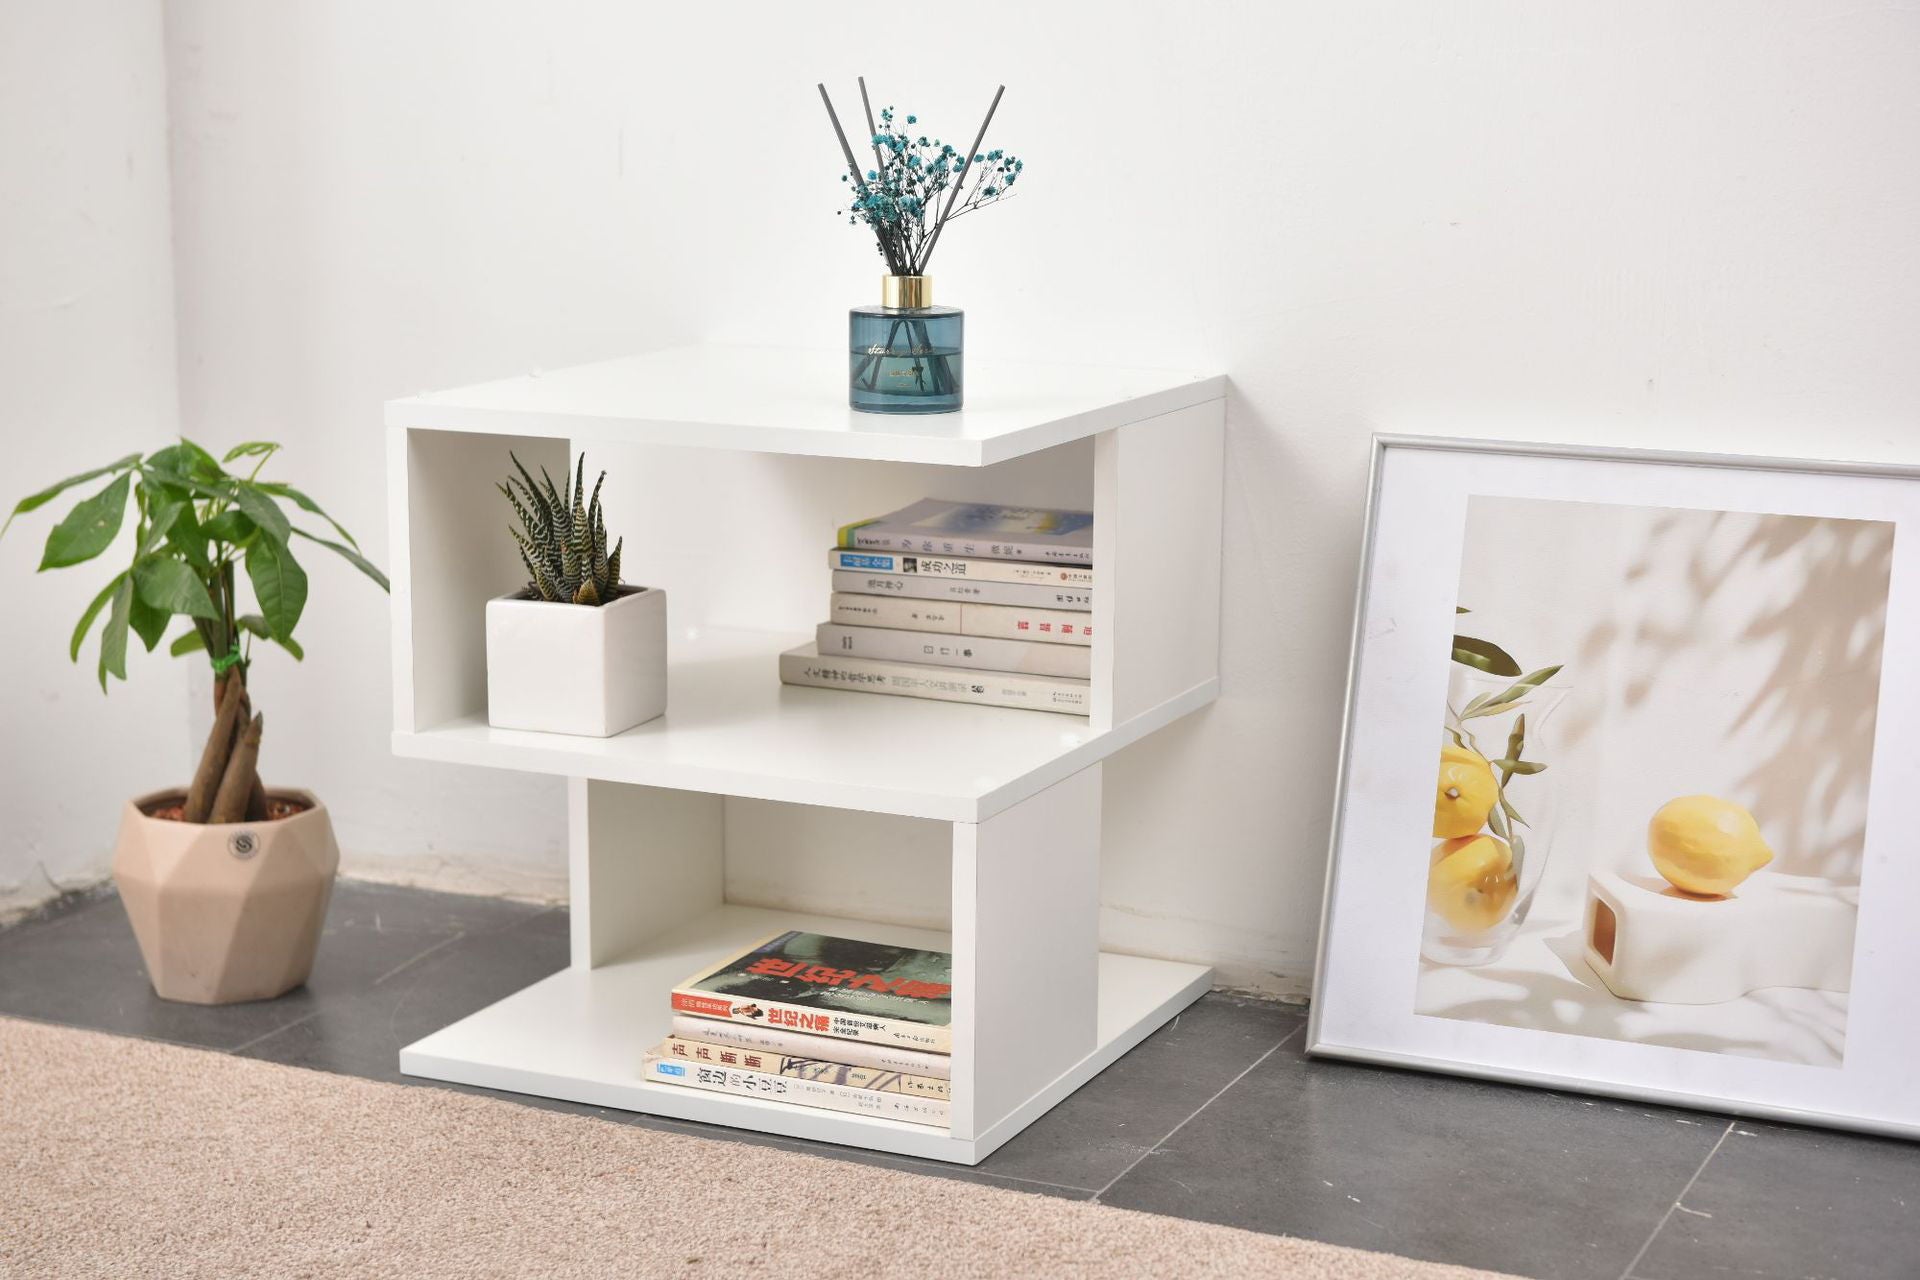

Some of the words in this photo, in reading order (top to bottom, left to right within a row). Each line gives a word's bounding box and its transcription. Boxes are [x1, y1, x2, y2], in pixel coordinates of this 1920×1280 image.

[920, 559, 967, 575] 成功之道
[767, 1006, 830, 1033] 世纪之痛
[671, 1042, 762, 1069] 声声断断
[696, 1066, 787, 1096] 窗边的小豆豆
